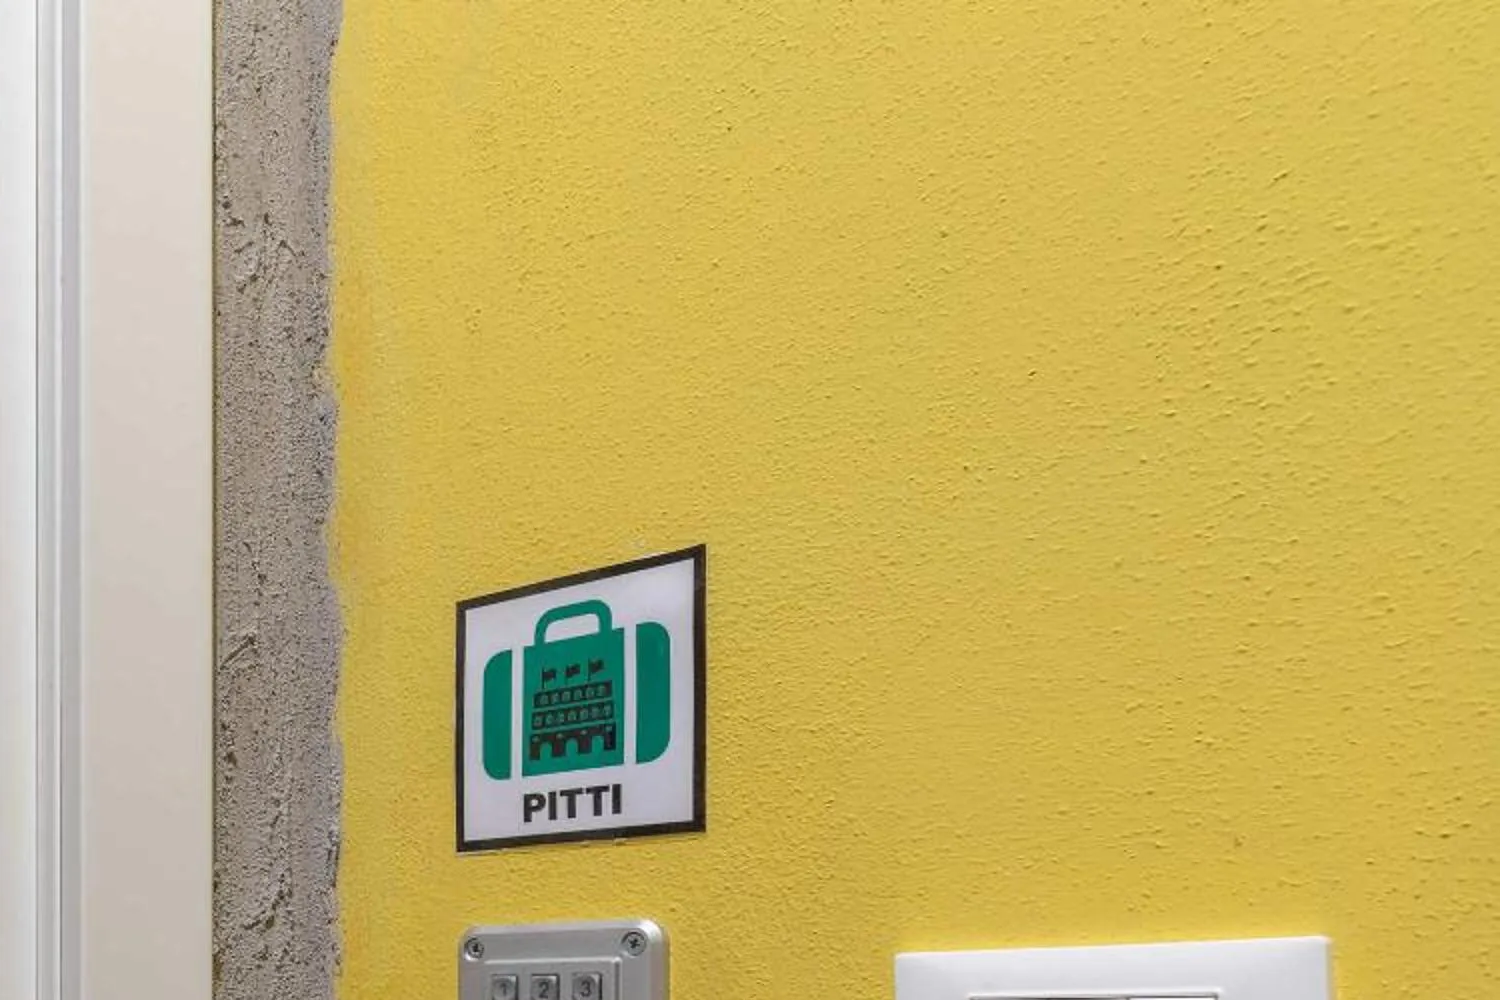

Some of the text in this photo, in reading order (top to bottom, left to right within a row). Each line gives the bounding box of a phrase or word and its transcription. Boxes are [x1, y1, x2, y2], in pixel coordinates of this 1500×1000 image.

[523, 783, 622, 823] PITTI
[537, 980, 550, 999] 2
[579, 980, 592, 998] 3
